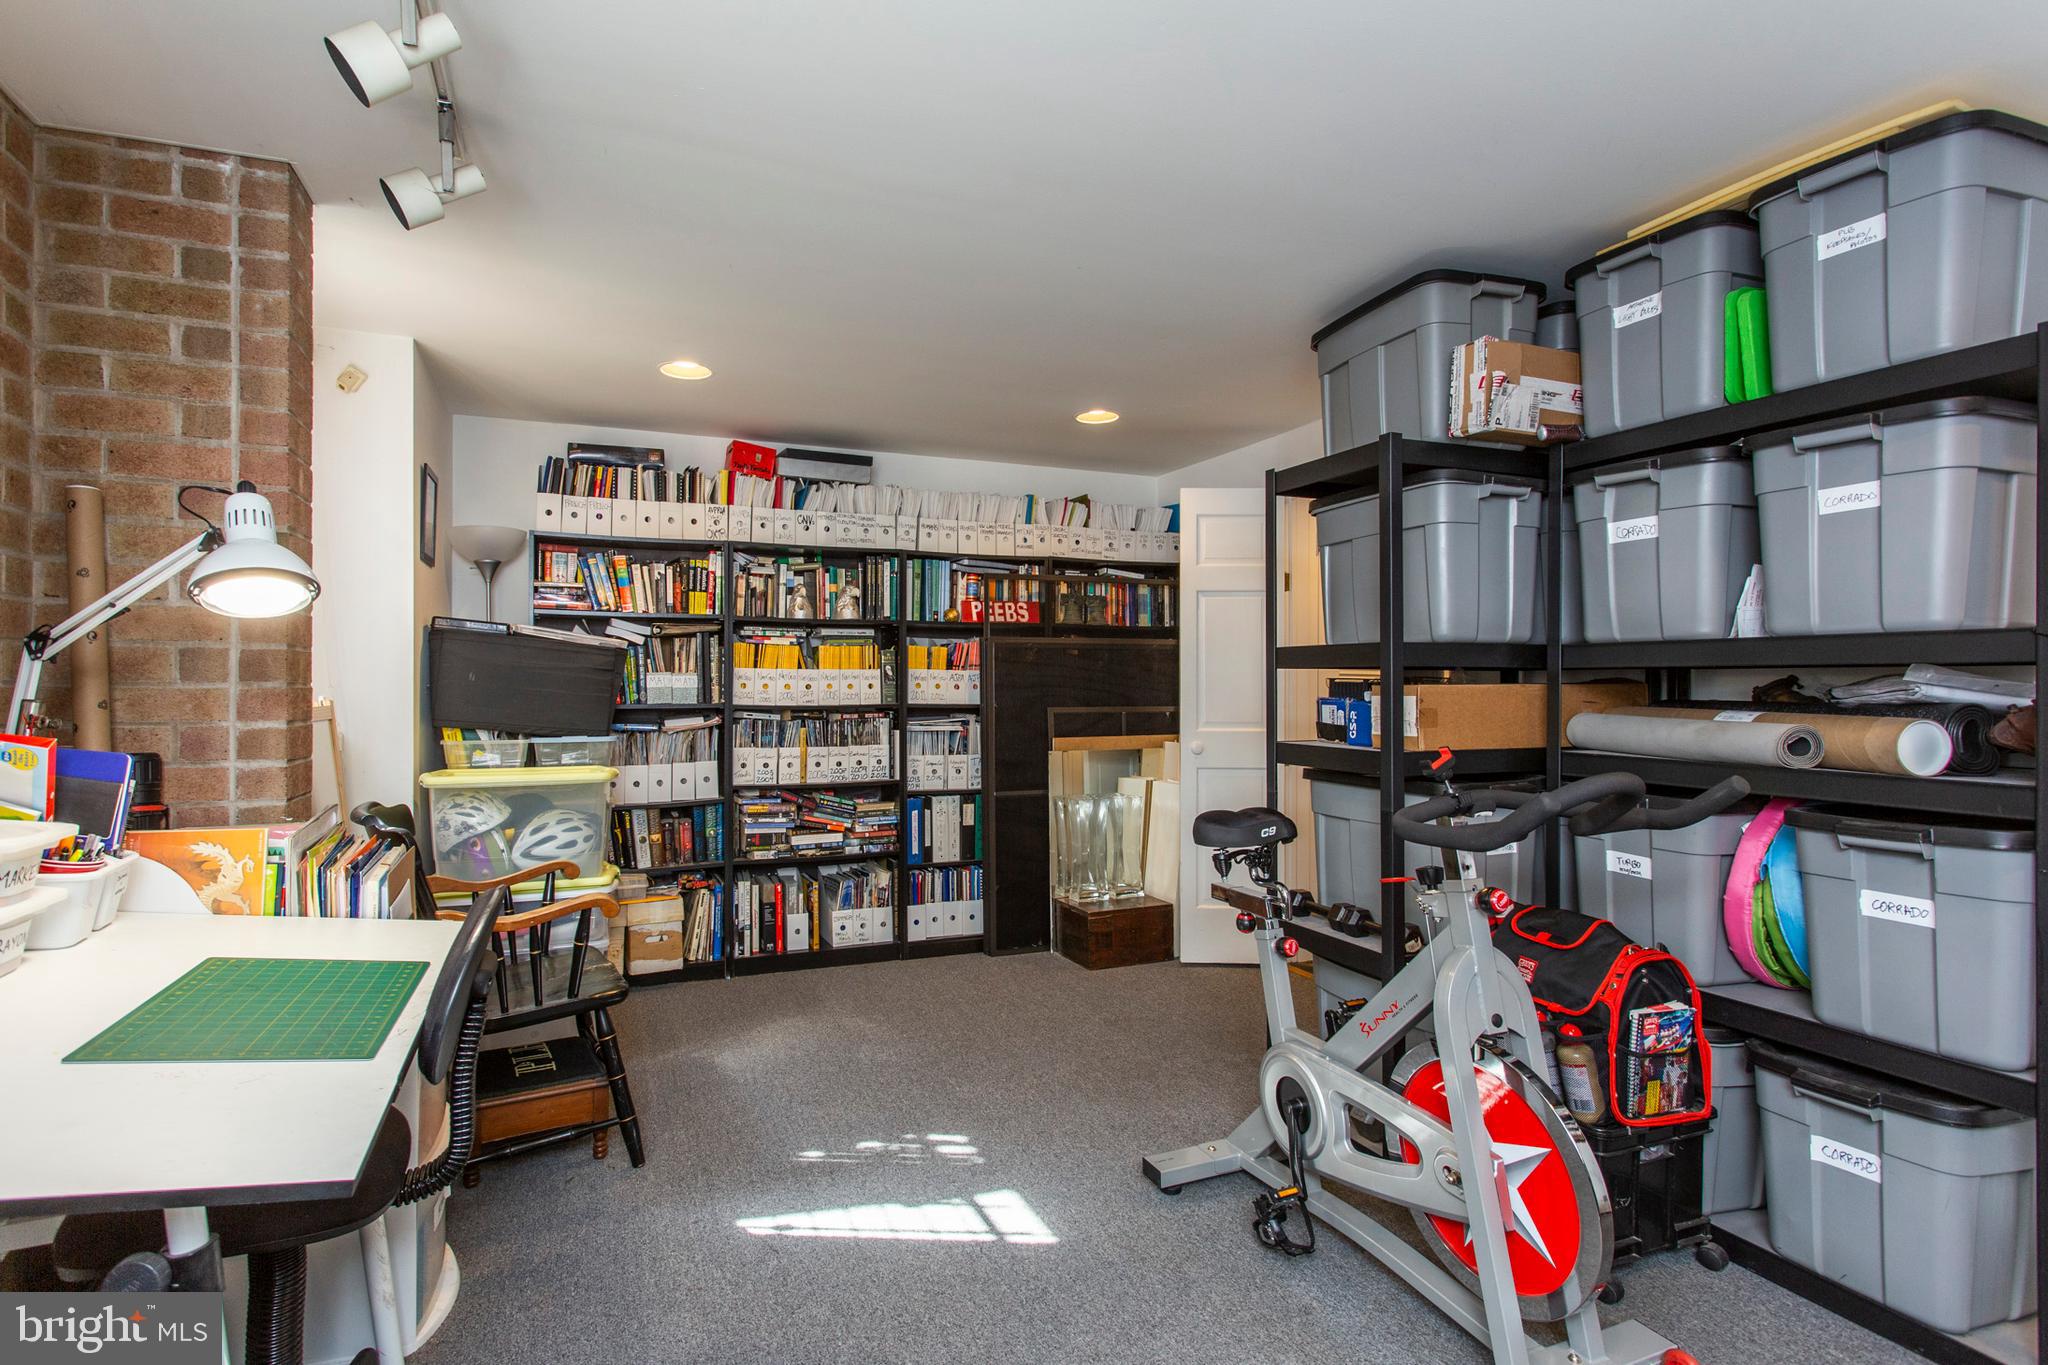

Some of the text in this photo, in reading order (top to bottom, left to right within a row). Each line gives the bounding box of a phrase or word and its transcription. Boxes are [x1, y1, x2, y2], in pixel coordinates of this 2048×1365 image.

[1260, 825, 1277, 838] C9
[1871, 899, 1930, 919] CORRADO
[1359, 999, 1399, 1039] SUNNY
[1821, 1144, 1879, 1174] CORRADO
